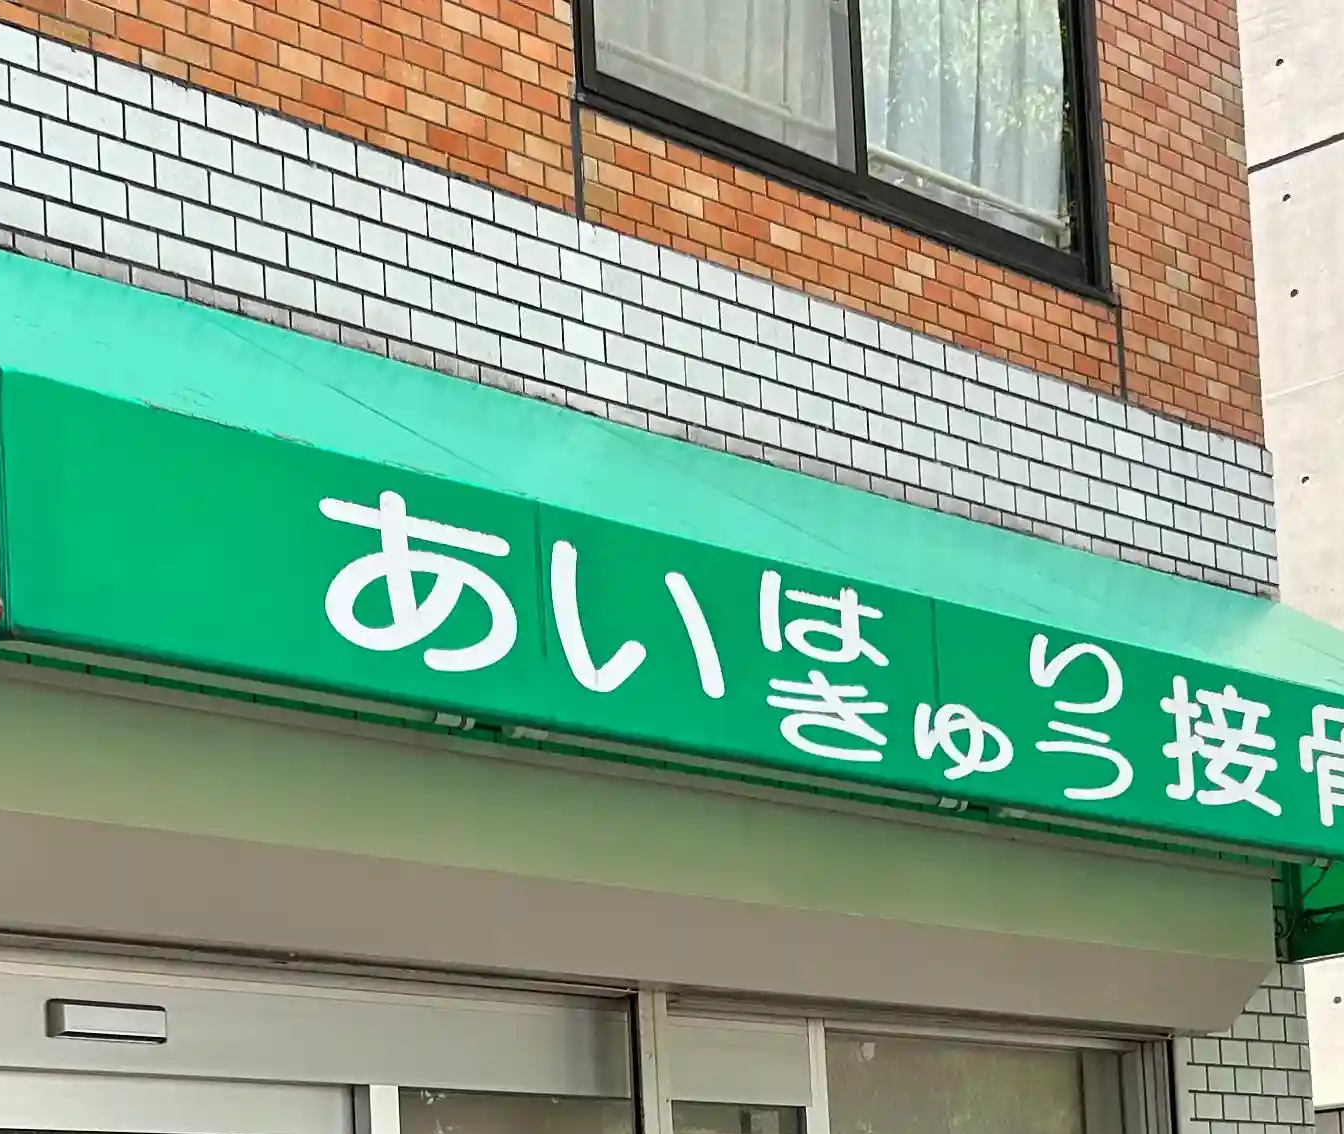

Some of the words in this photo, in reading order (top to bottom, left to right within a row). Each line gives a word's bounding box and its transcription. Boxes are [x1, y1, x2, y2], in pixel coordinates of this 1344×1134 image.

[320, 491, 724, 698] あい
[766, 668, 1133, 801] きゅう
